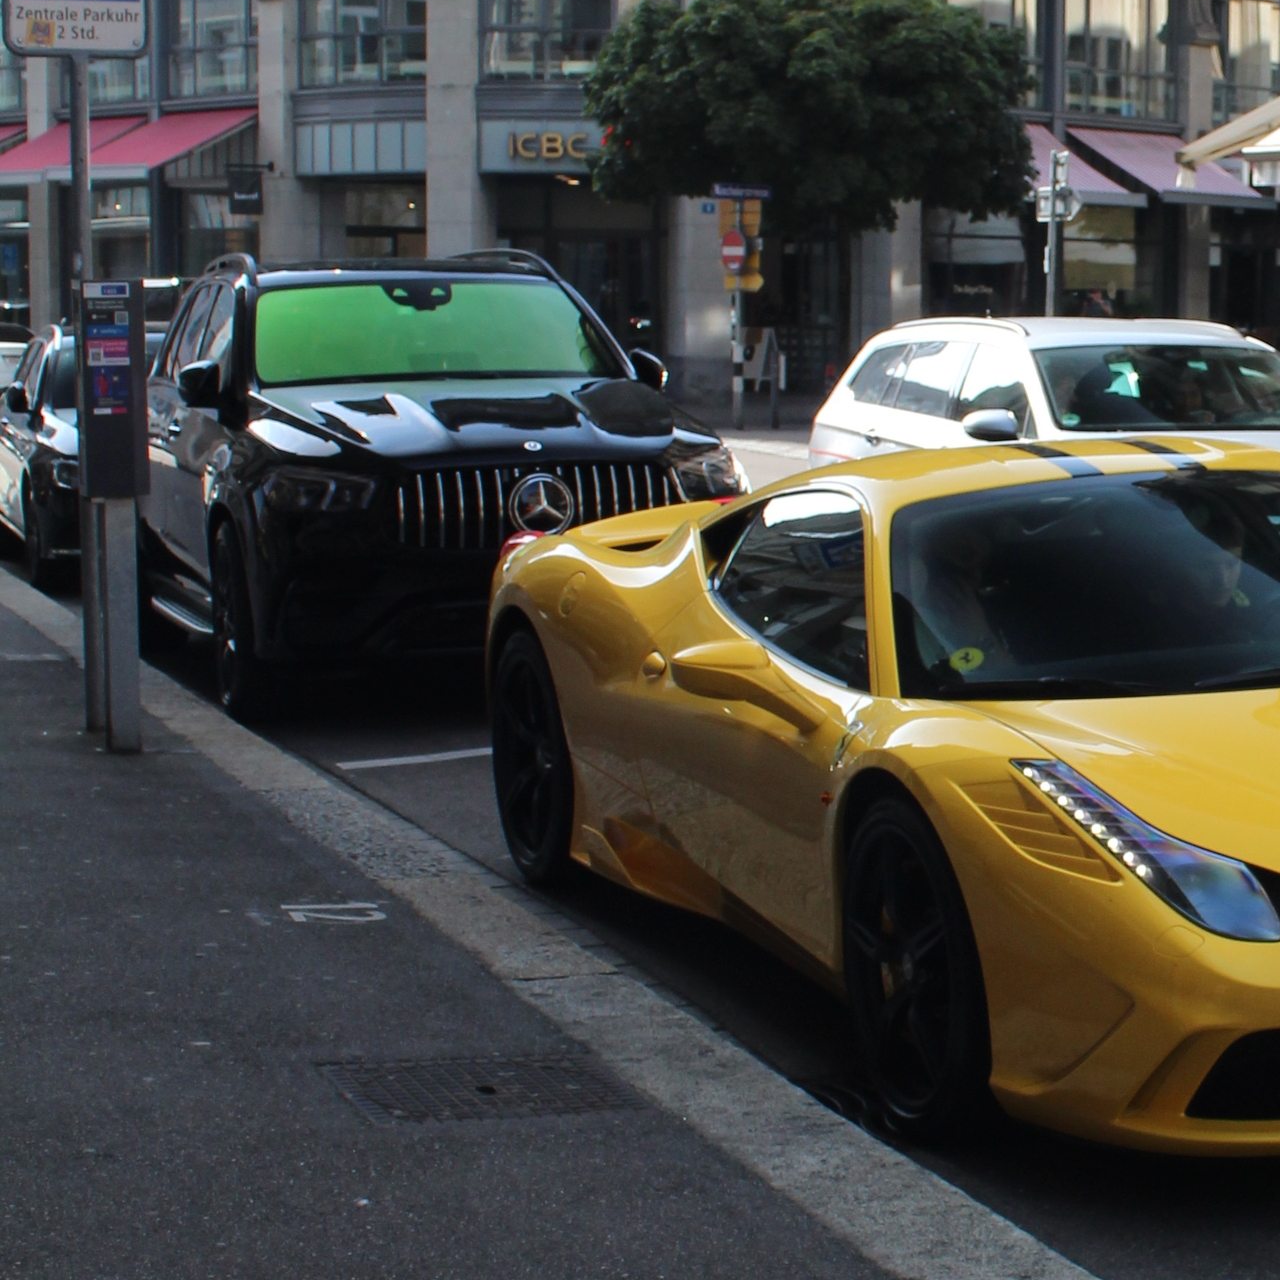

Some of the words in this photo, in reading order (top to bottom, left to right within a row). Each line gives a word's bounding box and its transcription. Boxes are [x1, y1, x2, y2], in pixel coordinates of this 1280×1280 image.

[16, 6, 78, 21] Zentrale
[84, 8, 140, 23] Parkuhr
[57, 25, 65, 39] 2
[71, 25, 99, 40] Std.
[508, 131, 589, 159] ICBC
